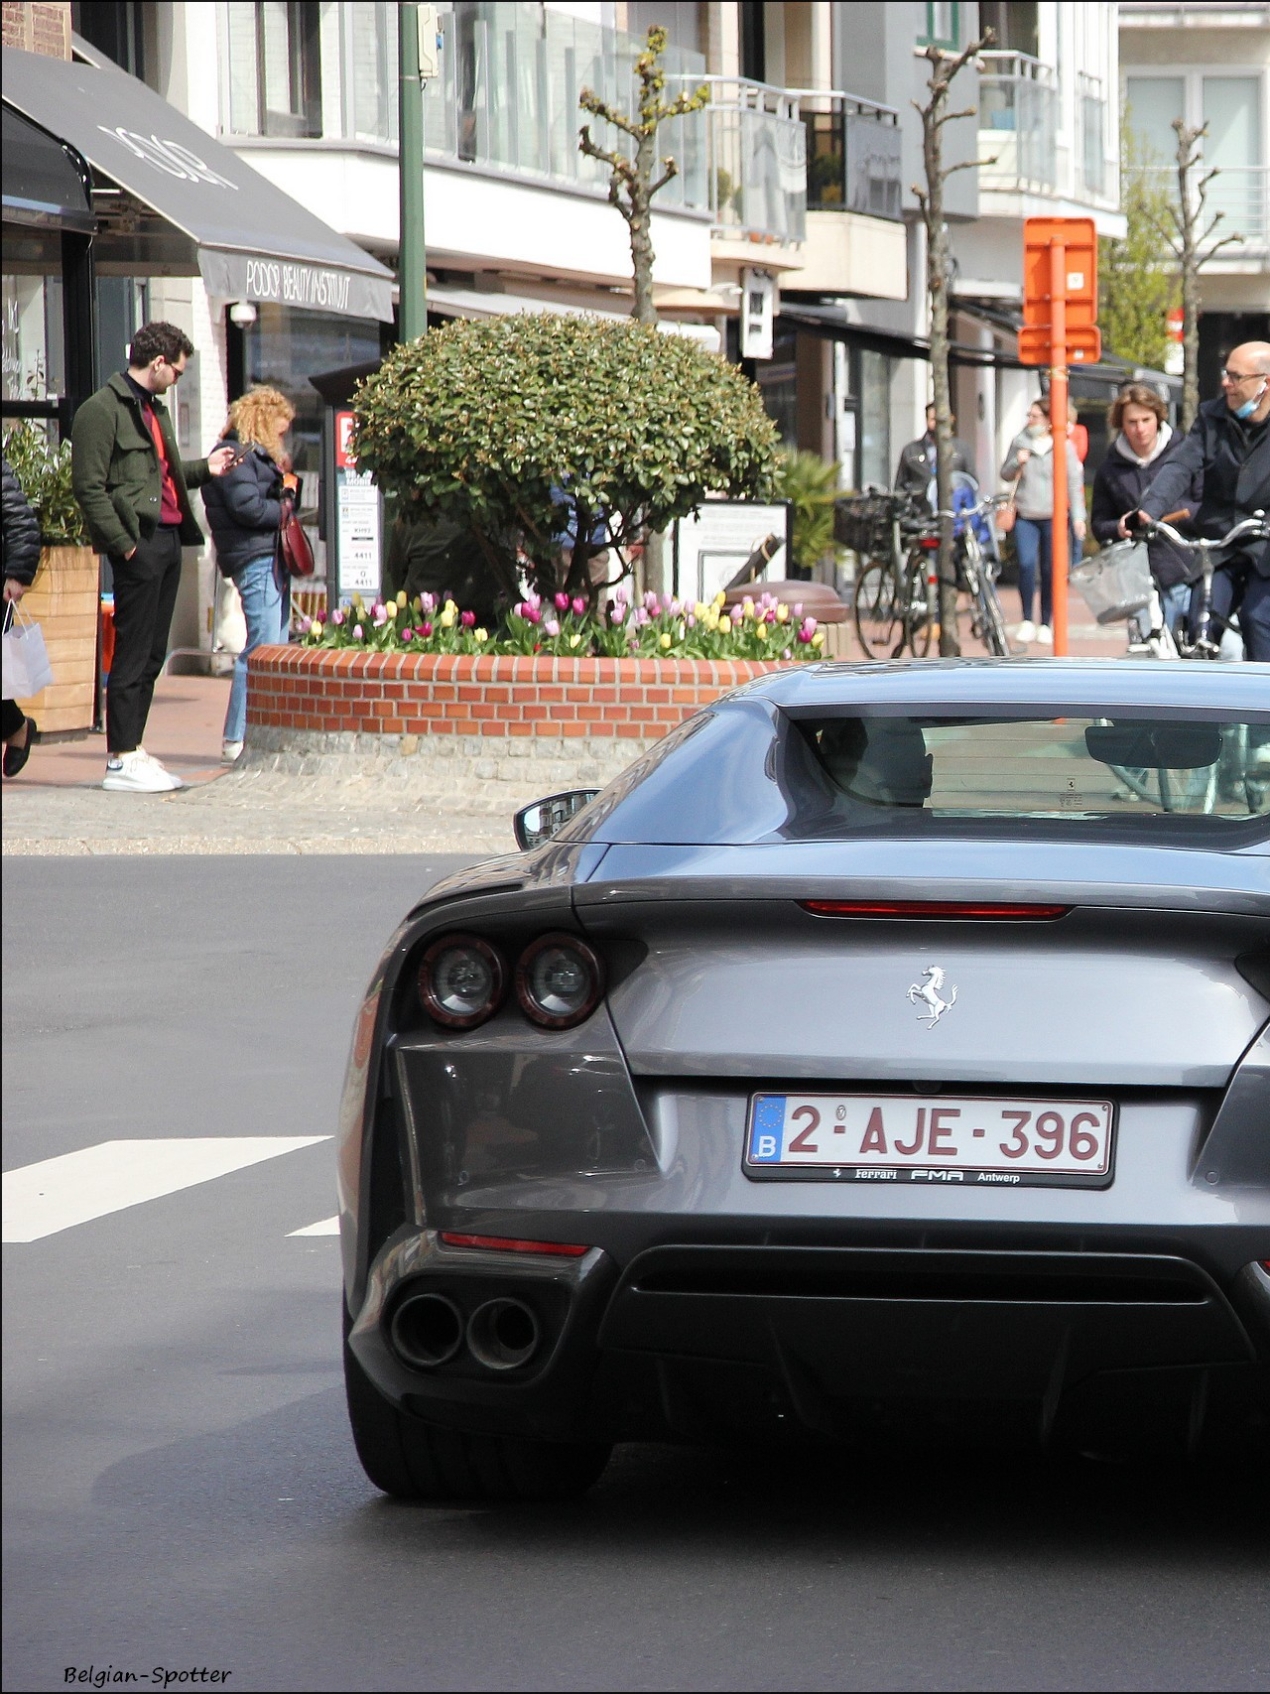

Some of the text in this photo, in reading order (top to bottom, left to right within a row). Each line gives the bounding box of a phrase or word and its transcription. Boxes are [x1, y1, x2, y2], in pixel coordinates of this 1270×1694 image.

[283, 265, 312, 304] BEAUTY
[354, 552, 372, 560] 4411
[758, 1135, 777, 1157] B
[855, 1168, 1020, 1184] Ferrari FMA Antwerp
